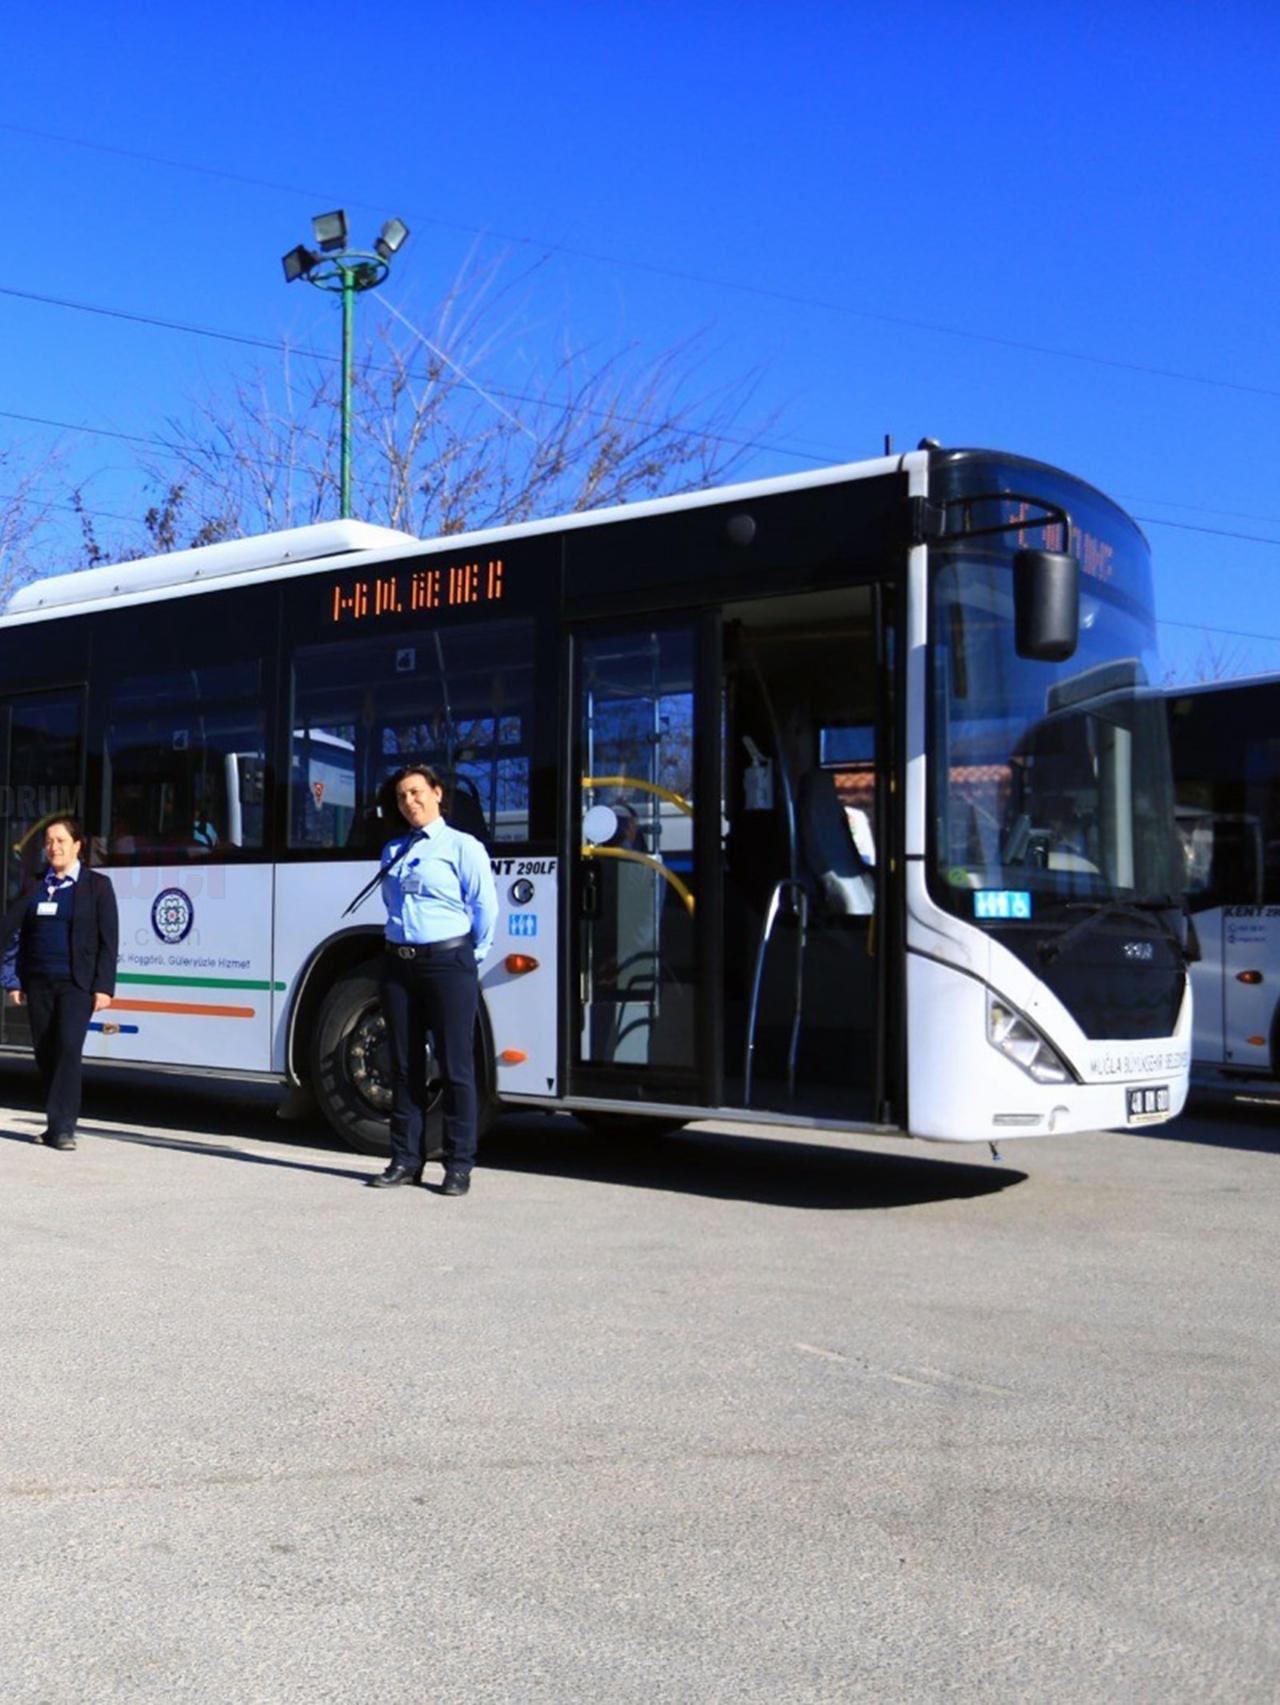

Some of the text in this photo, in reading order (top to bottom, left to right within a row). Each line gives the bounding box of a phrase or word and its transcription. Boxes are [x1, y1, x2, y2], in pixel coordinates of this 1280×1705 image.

[490, 860, 556, 875] NT 290LF
[218, 956, 251, 969] Hizmet
